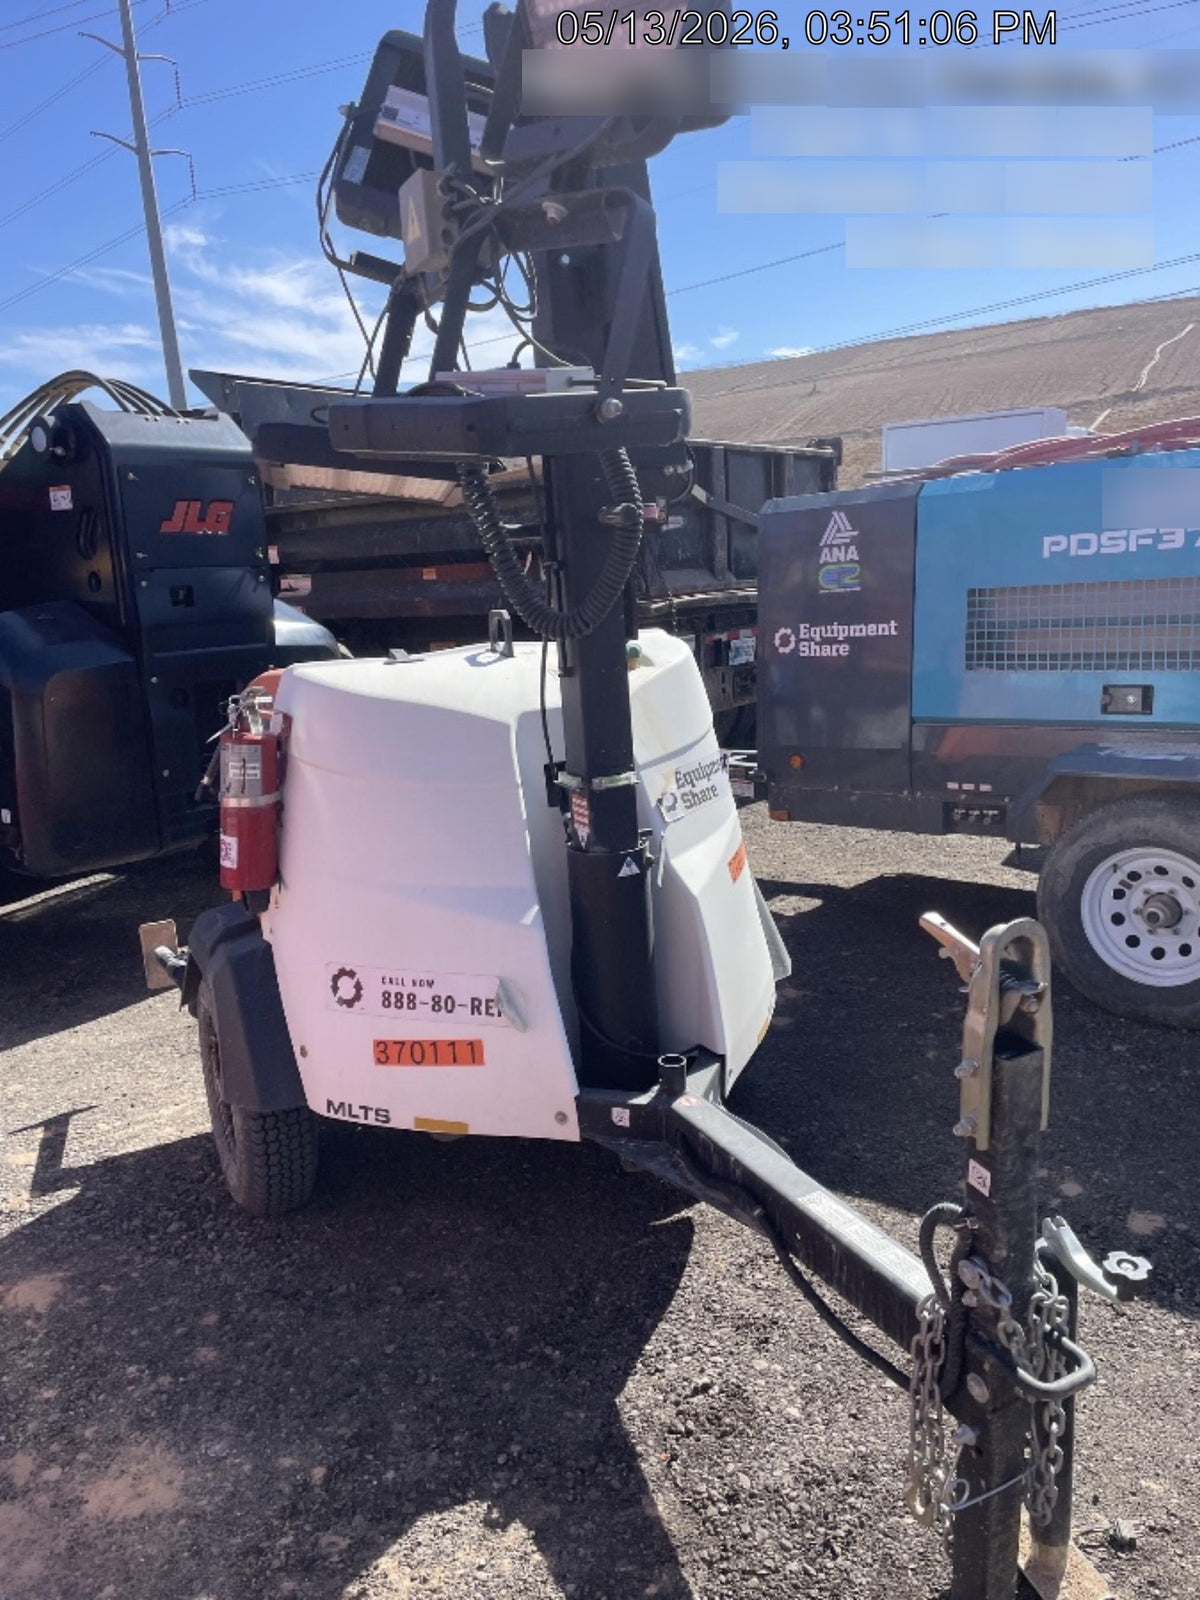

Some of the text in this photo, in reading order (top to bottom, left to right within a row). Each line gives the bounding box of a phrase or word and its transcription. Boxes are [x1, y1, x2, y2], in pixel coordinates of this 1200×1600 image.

[160, 500, 234, 535] JLG
[819, 546, 859, 564] ANA
[799, 620, 898, 641] Equipment
[799, 641, 849, 656] Share
[681, 784, 718, 809] Share
[375, 1040, 477, 1066] 370111
[326, 1098, 391, 1124] MLTS
